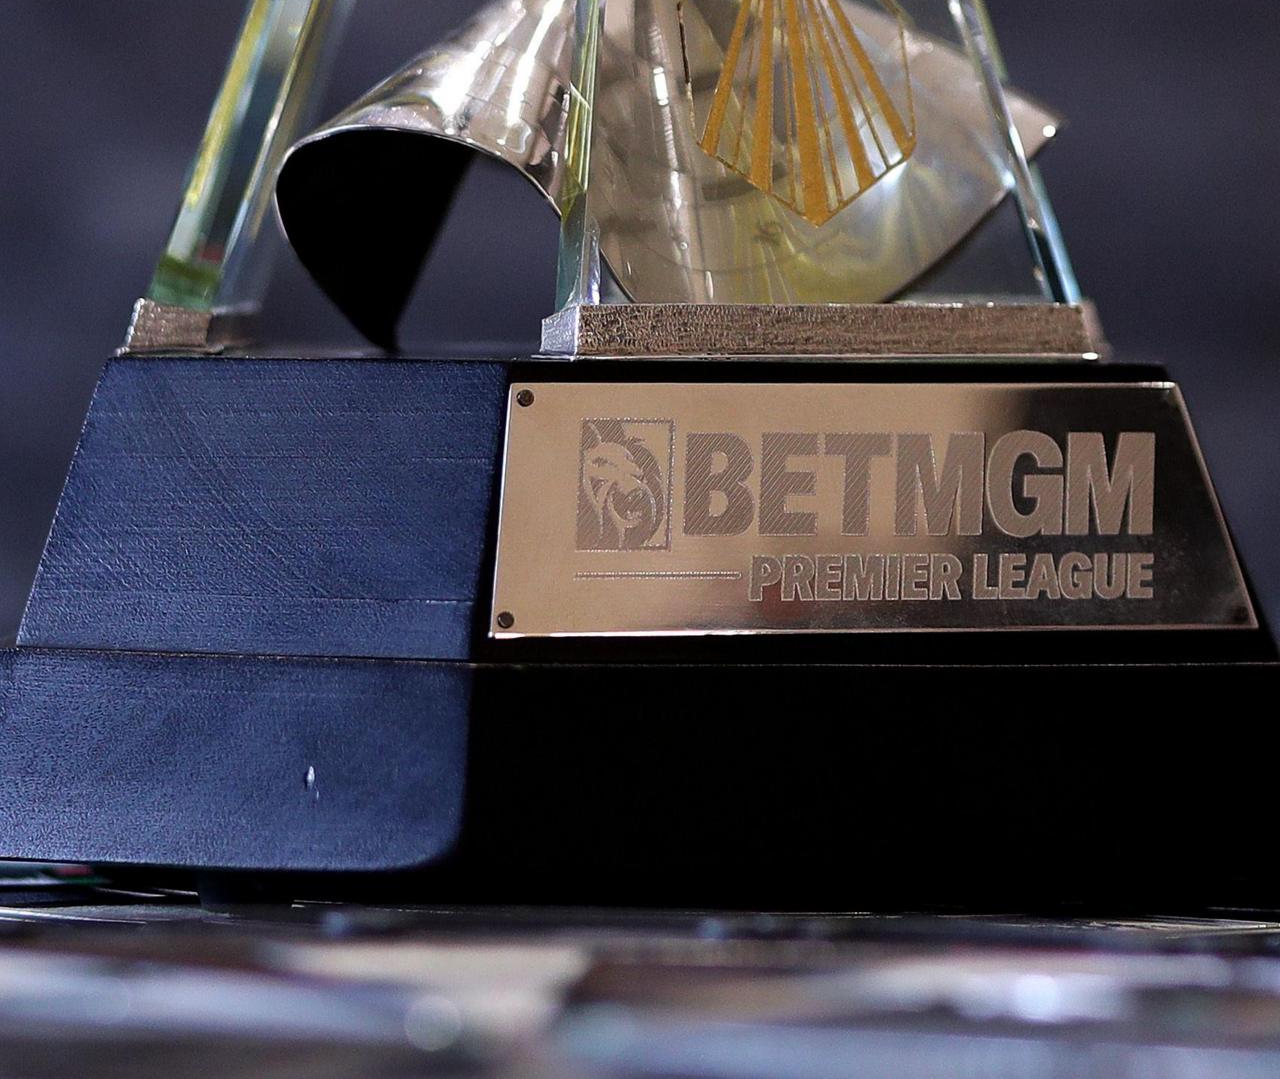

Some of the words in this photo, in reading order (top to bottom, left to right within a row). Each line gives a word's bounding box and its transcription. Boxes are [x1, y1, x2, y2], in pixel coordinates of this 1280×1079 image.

[682, 430, 1157, 538] BETMGM
[748, 554, 963, 602] PREMIER
[972, 553, 1156, 601] LEAGUE
